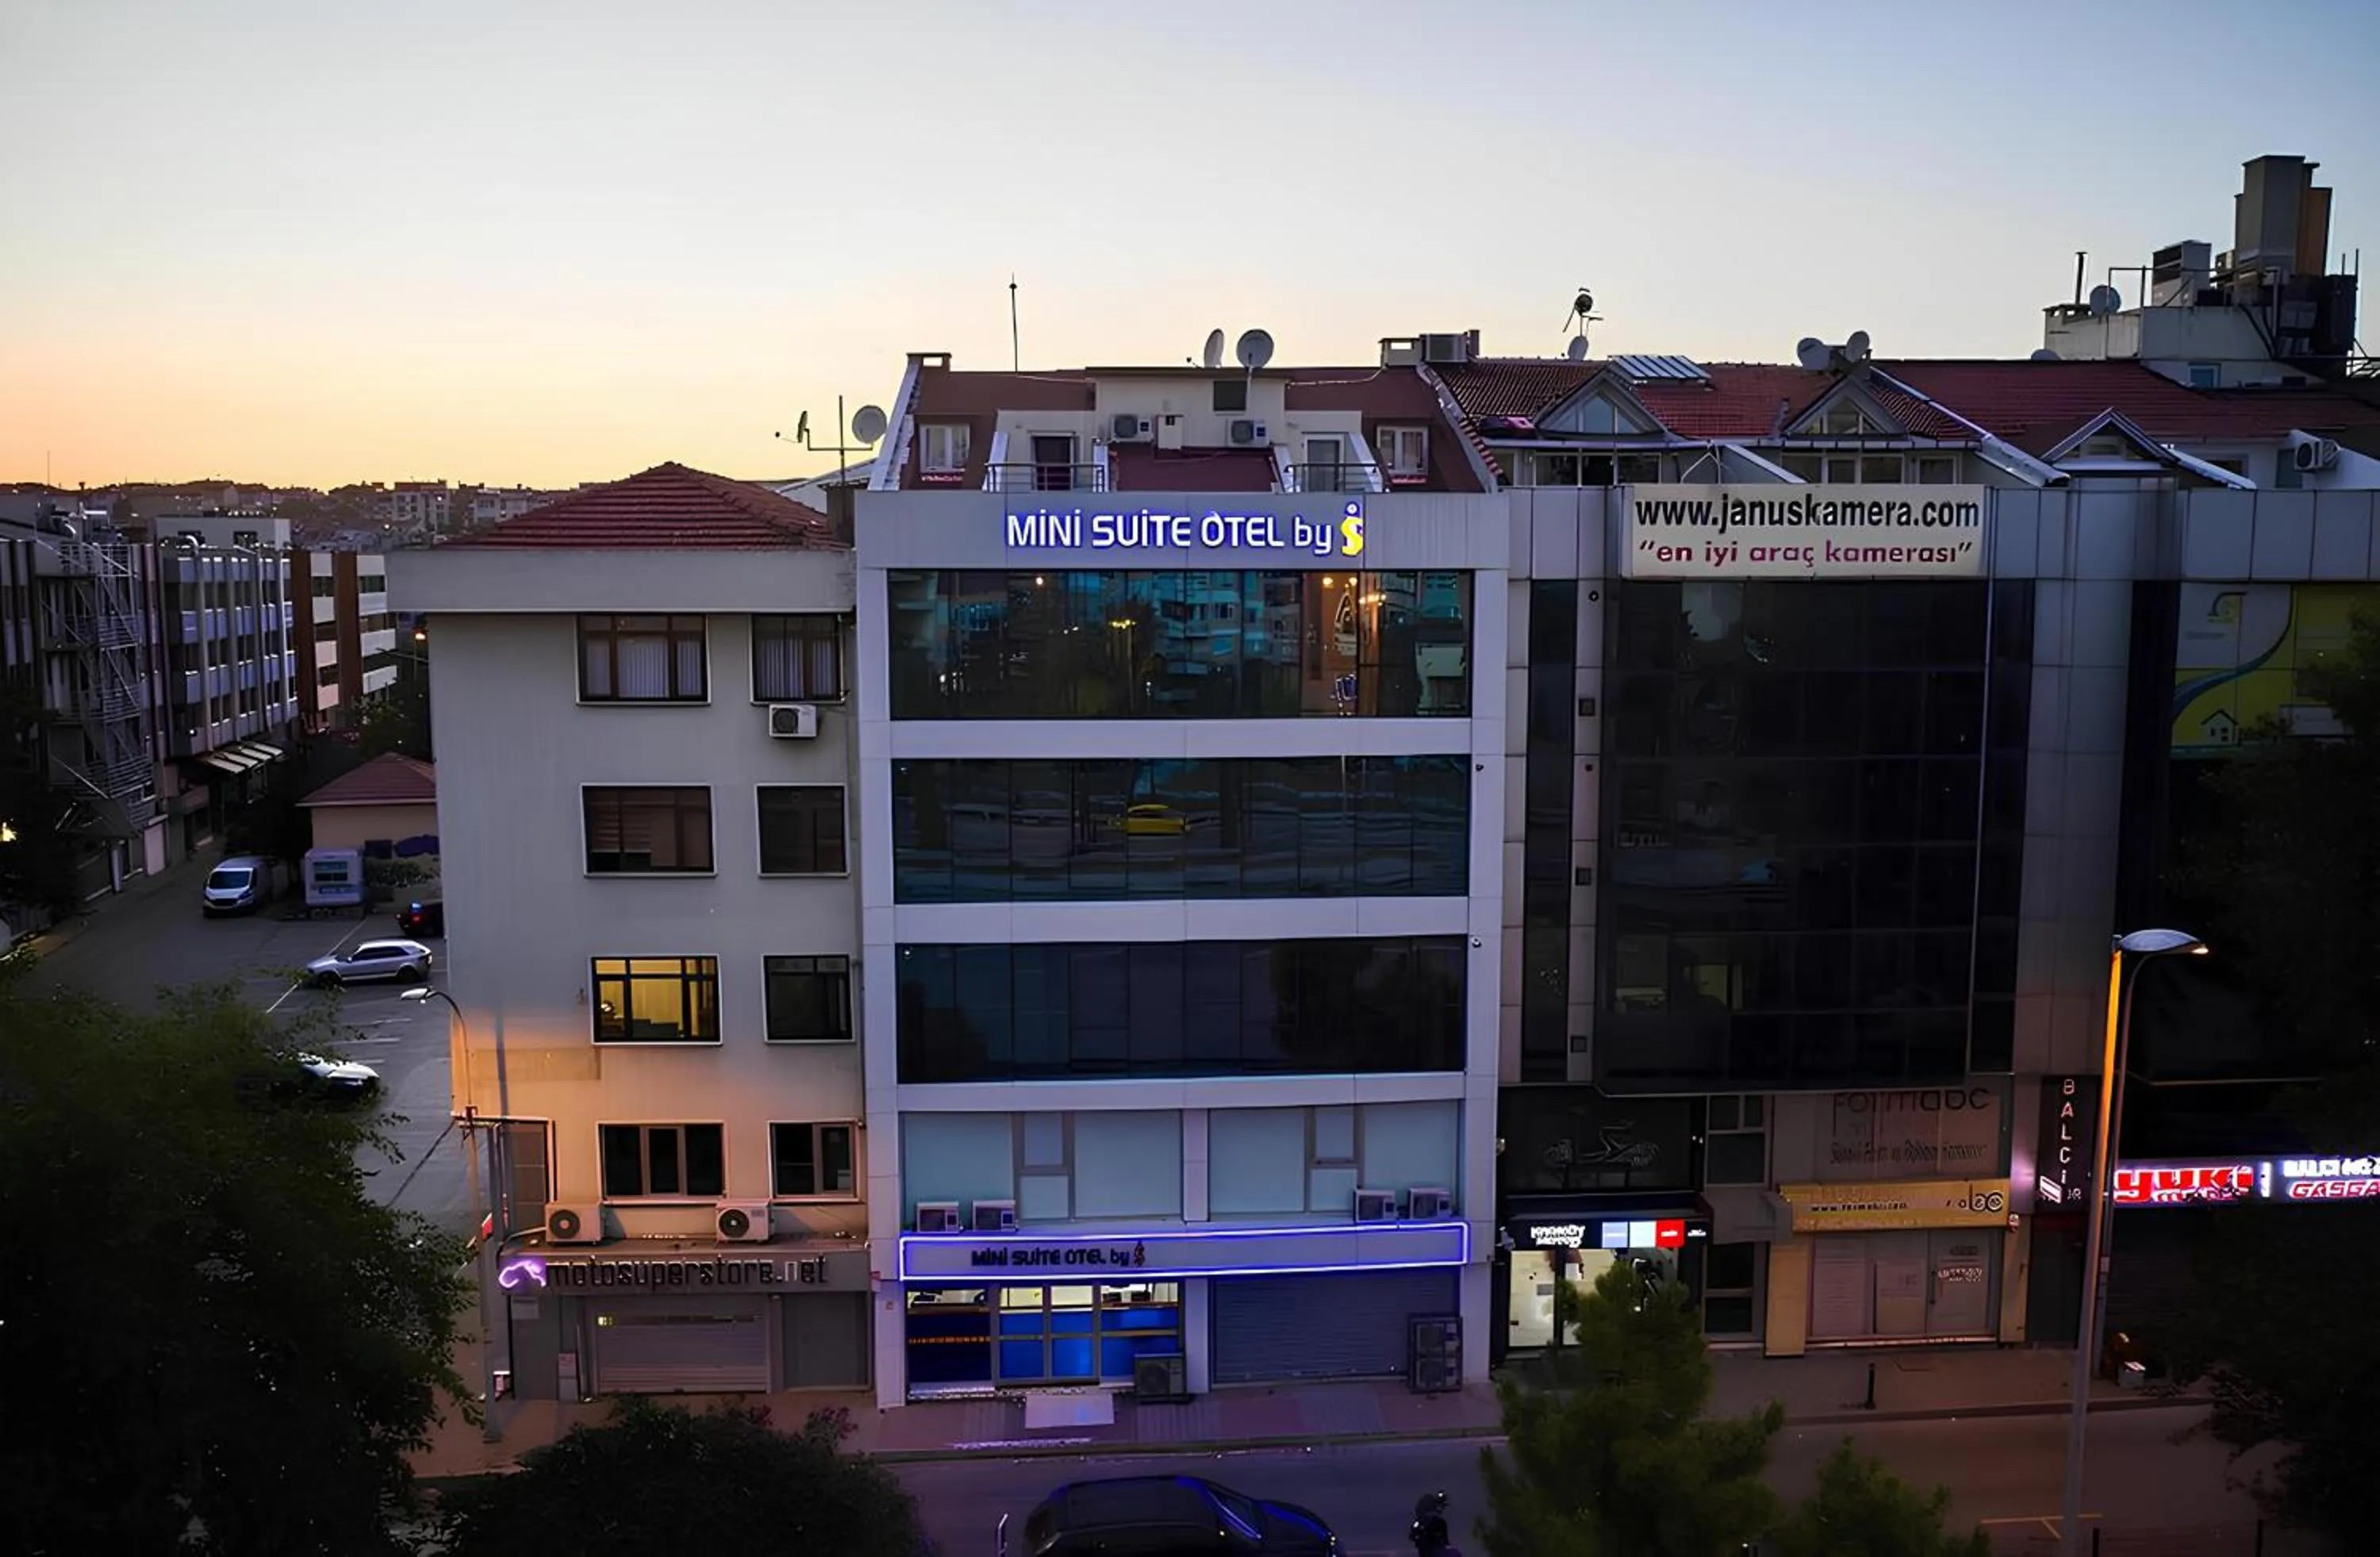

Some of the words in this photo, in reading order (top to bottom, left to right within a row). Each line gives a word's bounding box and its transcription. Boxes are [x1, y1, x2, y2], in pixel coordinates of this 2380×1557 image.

[1635, 493, 1979, 534] www.januskamera.com
[1294, 514, 1333, 555] by
[1705, 540, 1737, 564] iyi
[1749, 544, 1814, 568] araç
[545, 1255, 829, 1291] motosuperstore.net
[1111, 1248, 1130, 1267] by
